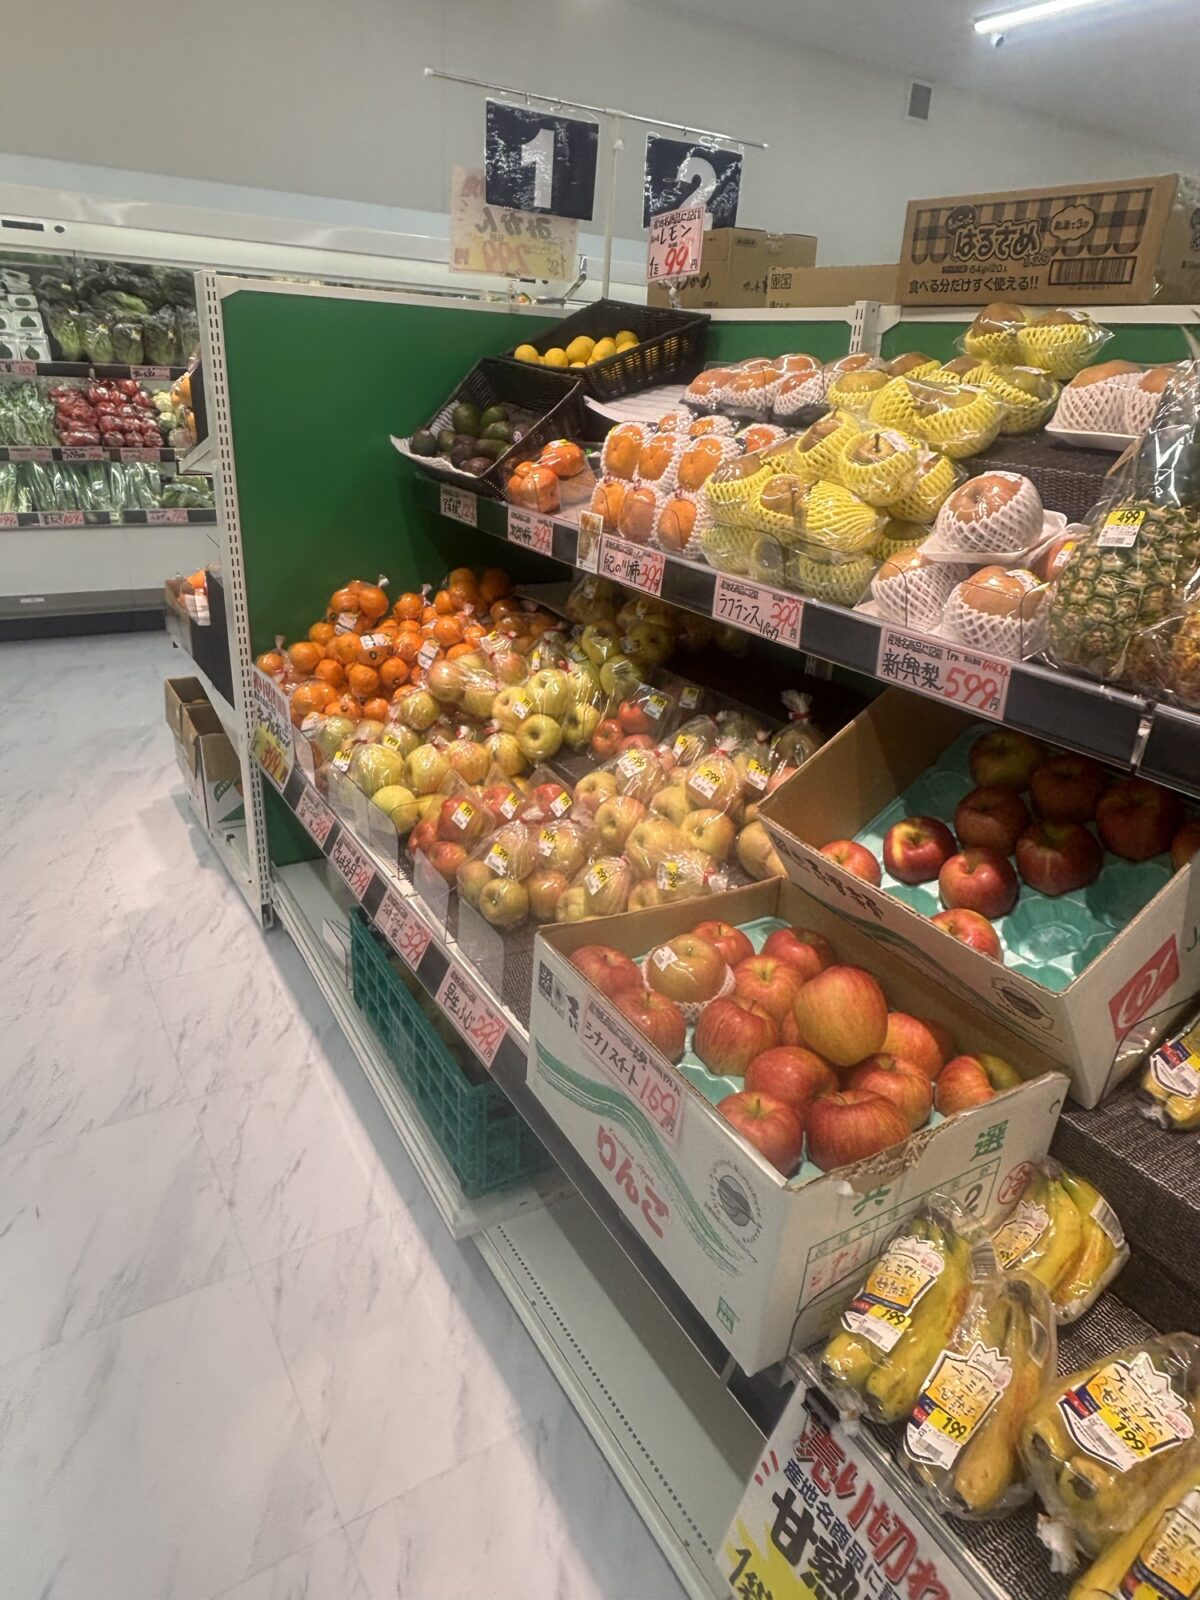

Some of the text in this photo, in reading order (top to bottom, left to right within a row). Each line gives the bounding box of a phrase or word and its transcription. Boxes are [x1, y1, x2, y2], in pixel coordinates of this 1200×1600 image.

[521, 128, 555, 209] 1
[677, 156, 717, 230] 2
[659, 226, 693, 246] レモン
[953, 221, 1041, 260] はるさめ
[664, 246, 690, 275] 99
[1117, 511, 1141, 523] 499
[719, 593, 761, 627] ラフランス
[882, 647, 945, 691] 新興梨
[943, 666, 999, 711] 599
[705, 770, 721, 784] 299
[443, 982, 476, 1030] 早生ふじ
[584, 1021, 639, 1087] シナノスイート
[881, 1309, 906, 1326] 199
[942, 1417, 967, 1438] 199
[1114, 1421, 1146, 1452] 199
